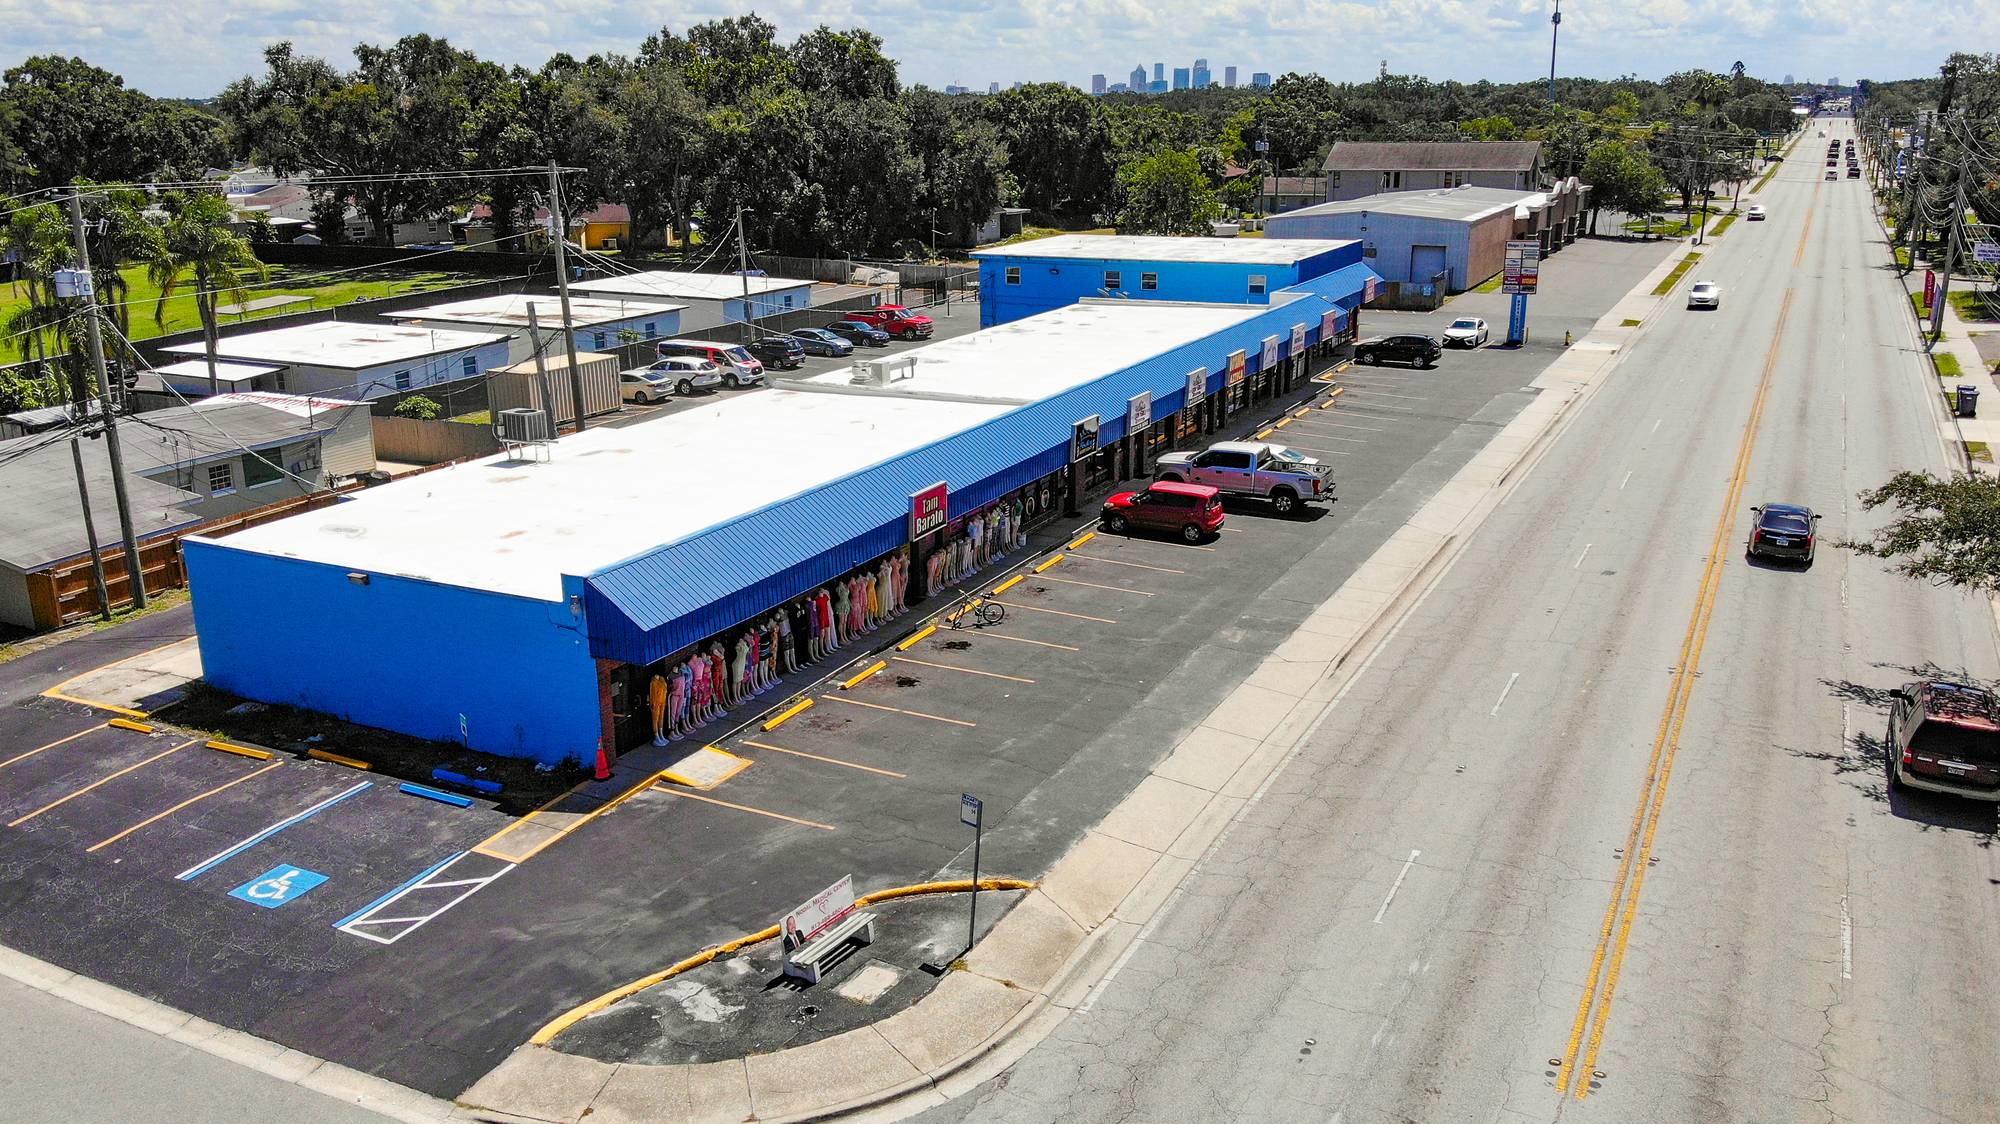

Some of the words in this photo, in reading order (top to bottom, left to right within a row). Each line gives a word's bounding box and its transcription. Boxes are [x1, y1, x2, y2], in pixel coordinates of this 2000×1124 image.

[922, 496, 939, 514] Tam
[917, 510, 943, 533] Barato
[812, 890, 833, 907] MEDICAL
